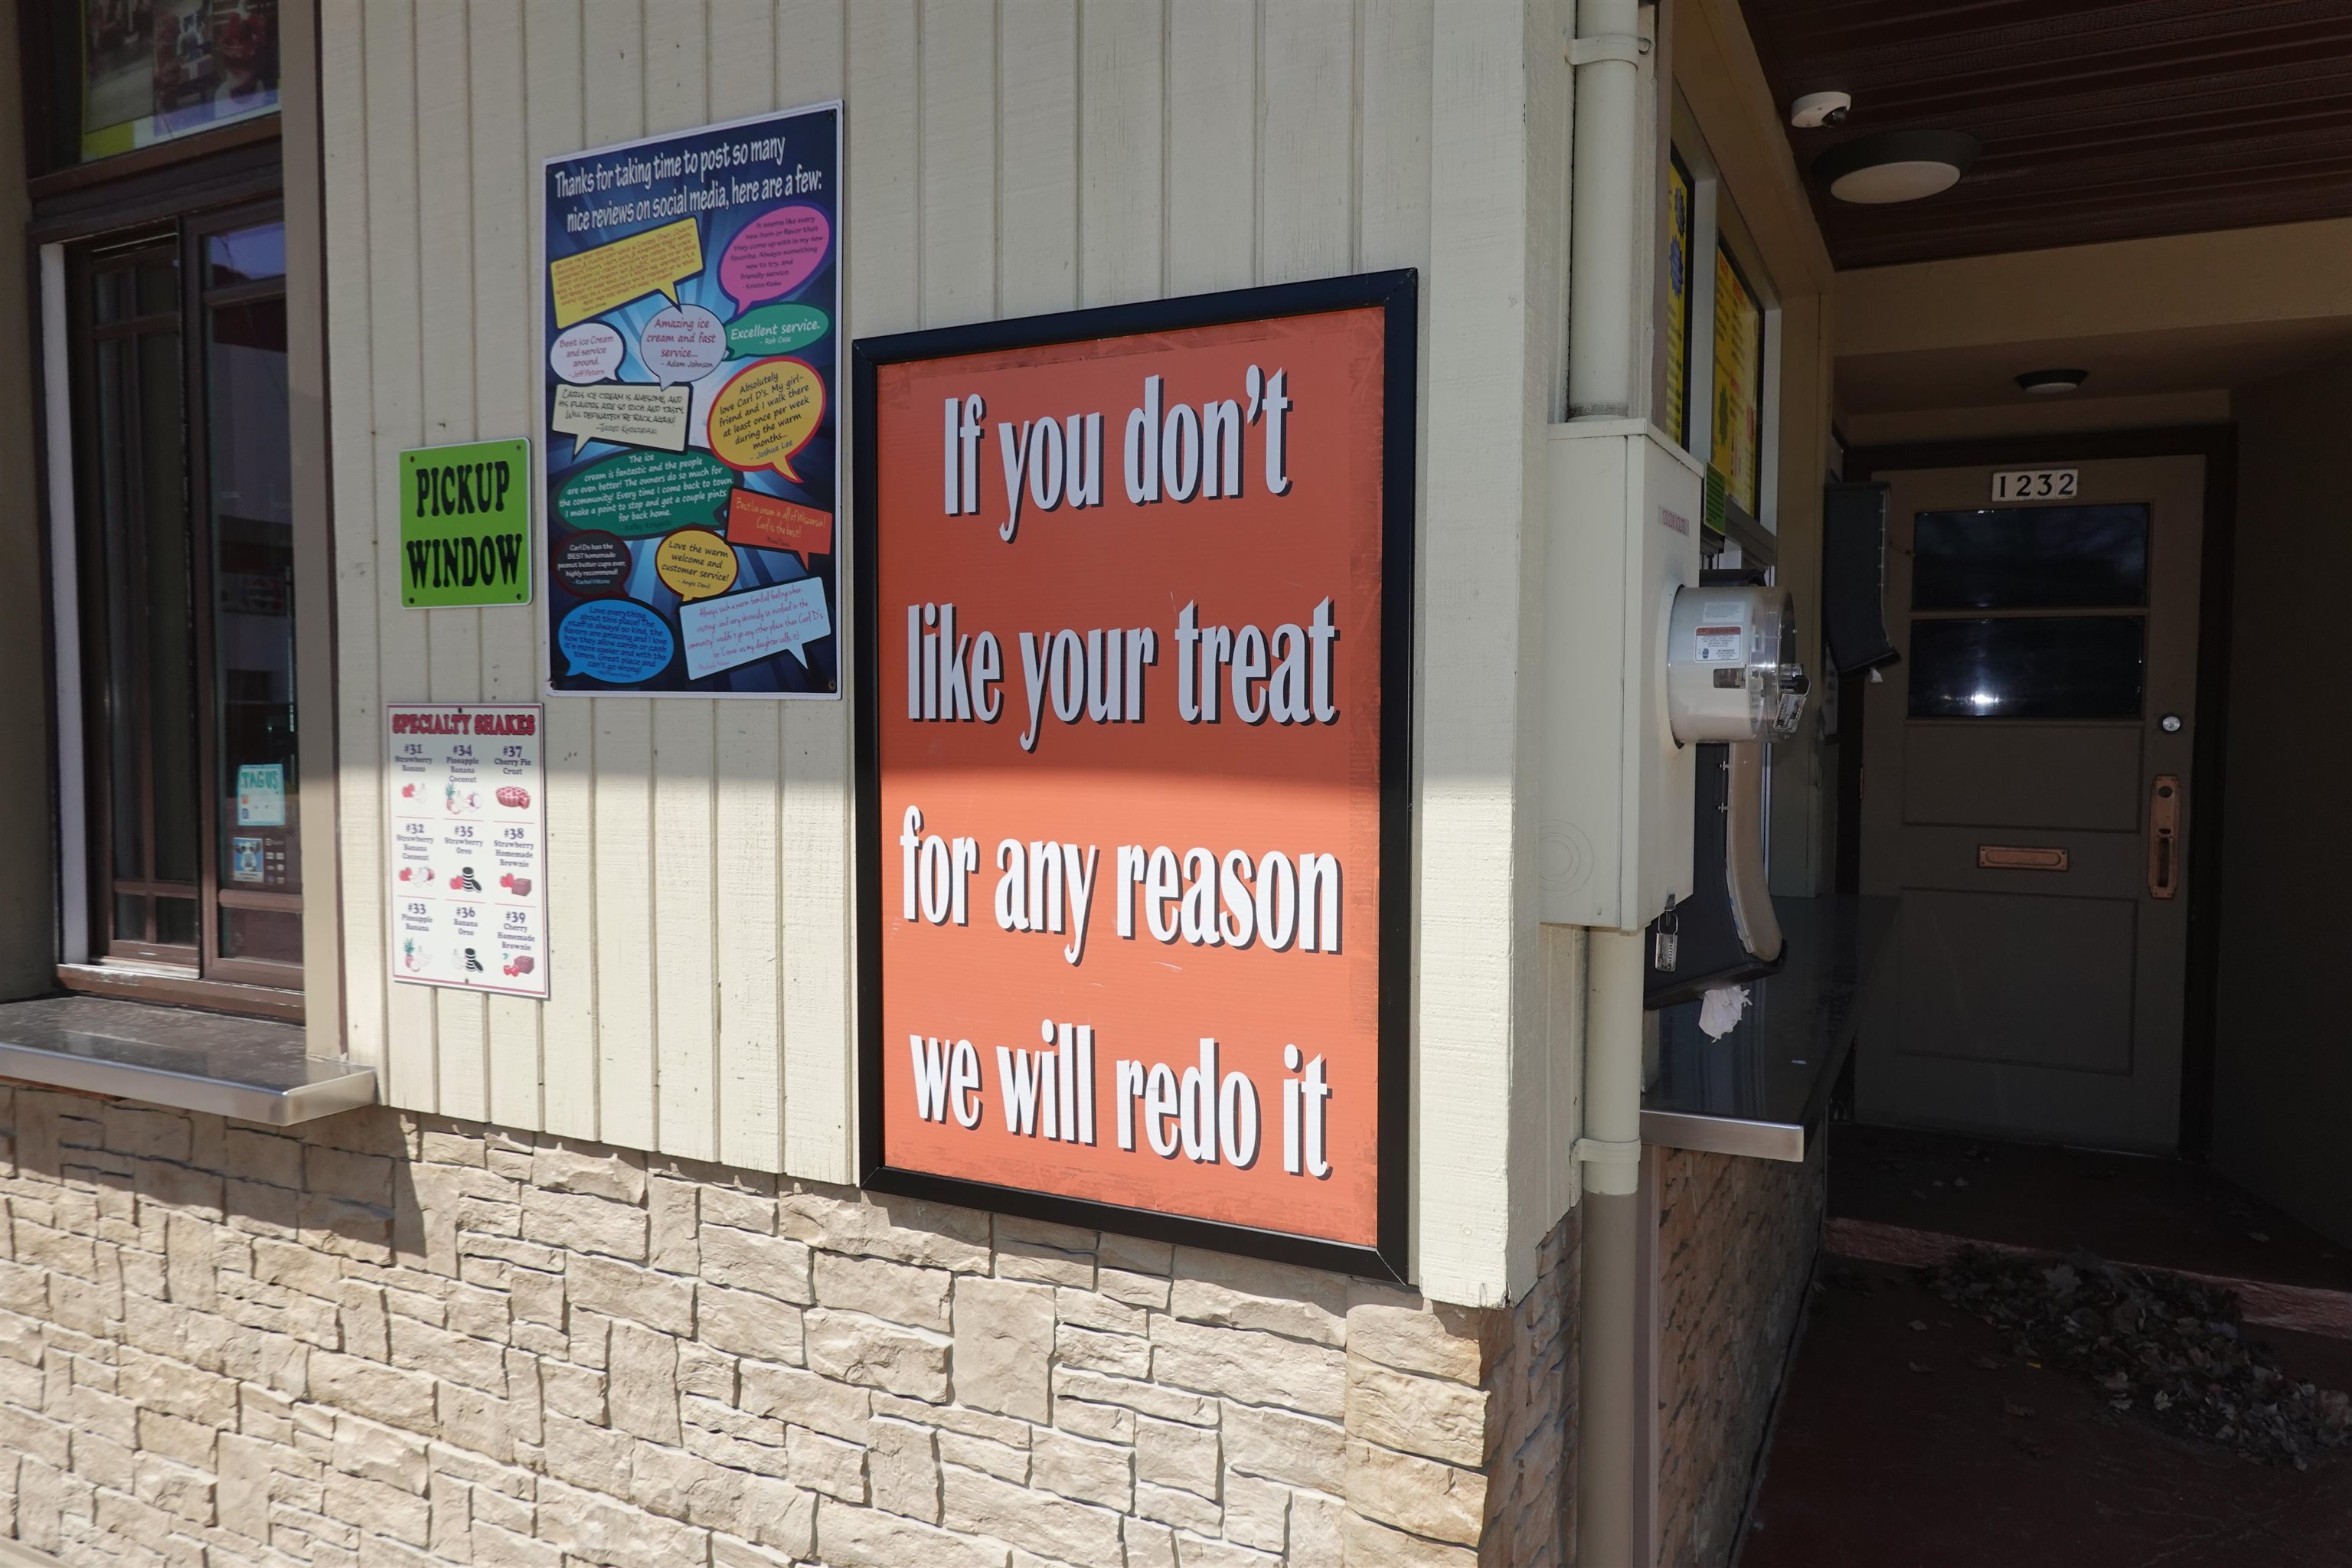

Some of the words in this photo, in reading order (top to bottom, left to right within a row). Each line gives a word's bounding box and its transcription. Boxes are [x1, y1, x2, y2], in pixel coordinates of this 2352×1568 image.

[555, 167, 595, 198] Thanks
[596, 163, 613, 191] for
[615, 158, 651, 190] taking
[653, 152, 681, 180] time
[684, 150, 698, 175] to
[701, 142, 730, 183] post
[733, 144, 748, 166] so
[751, 137, 786, 165] many
[567, 206, 590, 233] nice
[591, 201, 634, 229] reviews
[636, 200, 650, 221] on
[652, 185, 688, 218] social
[690, 180, 729, 212] media,
[731, 176, 760, 205] here
[762, 176, 782, 201] are
[785, 174, 793, 196] a
[795, 163, 822, 193] few:
[655, 317, 694, 332] Amazing
[697, 317, 710, 328] ice
[731, 323, 778, 340] Excellent
[781, 318, 820, 334] service.
[646, 334, 675, 343] cream
[678, 332, 696, 343] and
[698, 332, 716, 344] fast
[740, 372, 779, 394] Absolutely
[720, 403, 735, 415] love
[737, 394, 753, 407] Carl
[771, 384, 783, 394] My
[720, 410, 742, 427] friend
[745, 404, 760, 416] and
[767, 394, 786, 407] walk
[788, 384, 809, 398] there
[723, 429, 731, 438] at
[733, 420, 751, 433] least
[753, 413, 771, 425] once
[773, 406, 786, 420] per
[789, 396, 810, 410] week
[735, 429, 760, 445] during
[763, 423, 776, 433] the
[778, 413, 802, 427] warm
[629, 455, 642, 463] The
[645, 453, 655, 462] ice
[945, 394, 985, 517] If
[998, 412, 1102, 543] you
[1124, 364, 1291, 505] don't
[583, 473, 606, 482] cream
[608, 469, 614, 479] is
[616, 465, 646, 477] fantastic
[648, 462, 663, 472] and
[665, 461, 677, 470] the
[679, 456, 703, 471] people
[416, 460, 510, 518] PICKUP
[2000, 473, 2074, 498] 1232
[668, 541, 687, 550] Love
[689, 544, 702, 553] the
[705, 549, 728, 557] warm
[407, 534, 523, 589] WINDOW
[662, 564, 698, 575] customer
[671, 554, 704, 565] welcome
[707, 560, 723, 569] and
[908, 603, 1003, 723] like
[1019, 627, 1157, 753] your
[1174, 596, 1338, 726] treat
[392, 714, 472, 735] SPECIALTY
[474, 714, 536, 736] SHAKES
[404, 743, 423, 755] #31
[452, 745, 472, 756] #34
[503, 746, 522, 757] #37
[494, 758, 518, 767] Cherry
[406, 823, 425, 834] #32
[454, 826, 473, 838] #35
[504, 828, 524, 840] #38
[900, 805, 979, 926] for
[995, 839, 1099, 966] any
[1117, 845, 1342, 954] reason
[407, 903, 426, 914] #33
[456, 906, 475, 918] #36
[506, 911, 526, 923] #39
[910, 1034, 982, 1130] we
[996, 1019, 1096, 1146] will
[1116, 1038, 1261, 1170] redo
[1284, 1044, 1333, 1180] it
